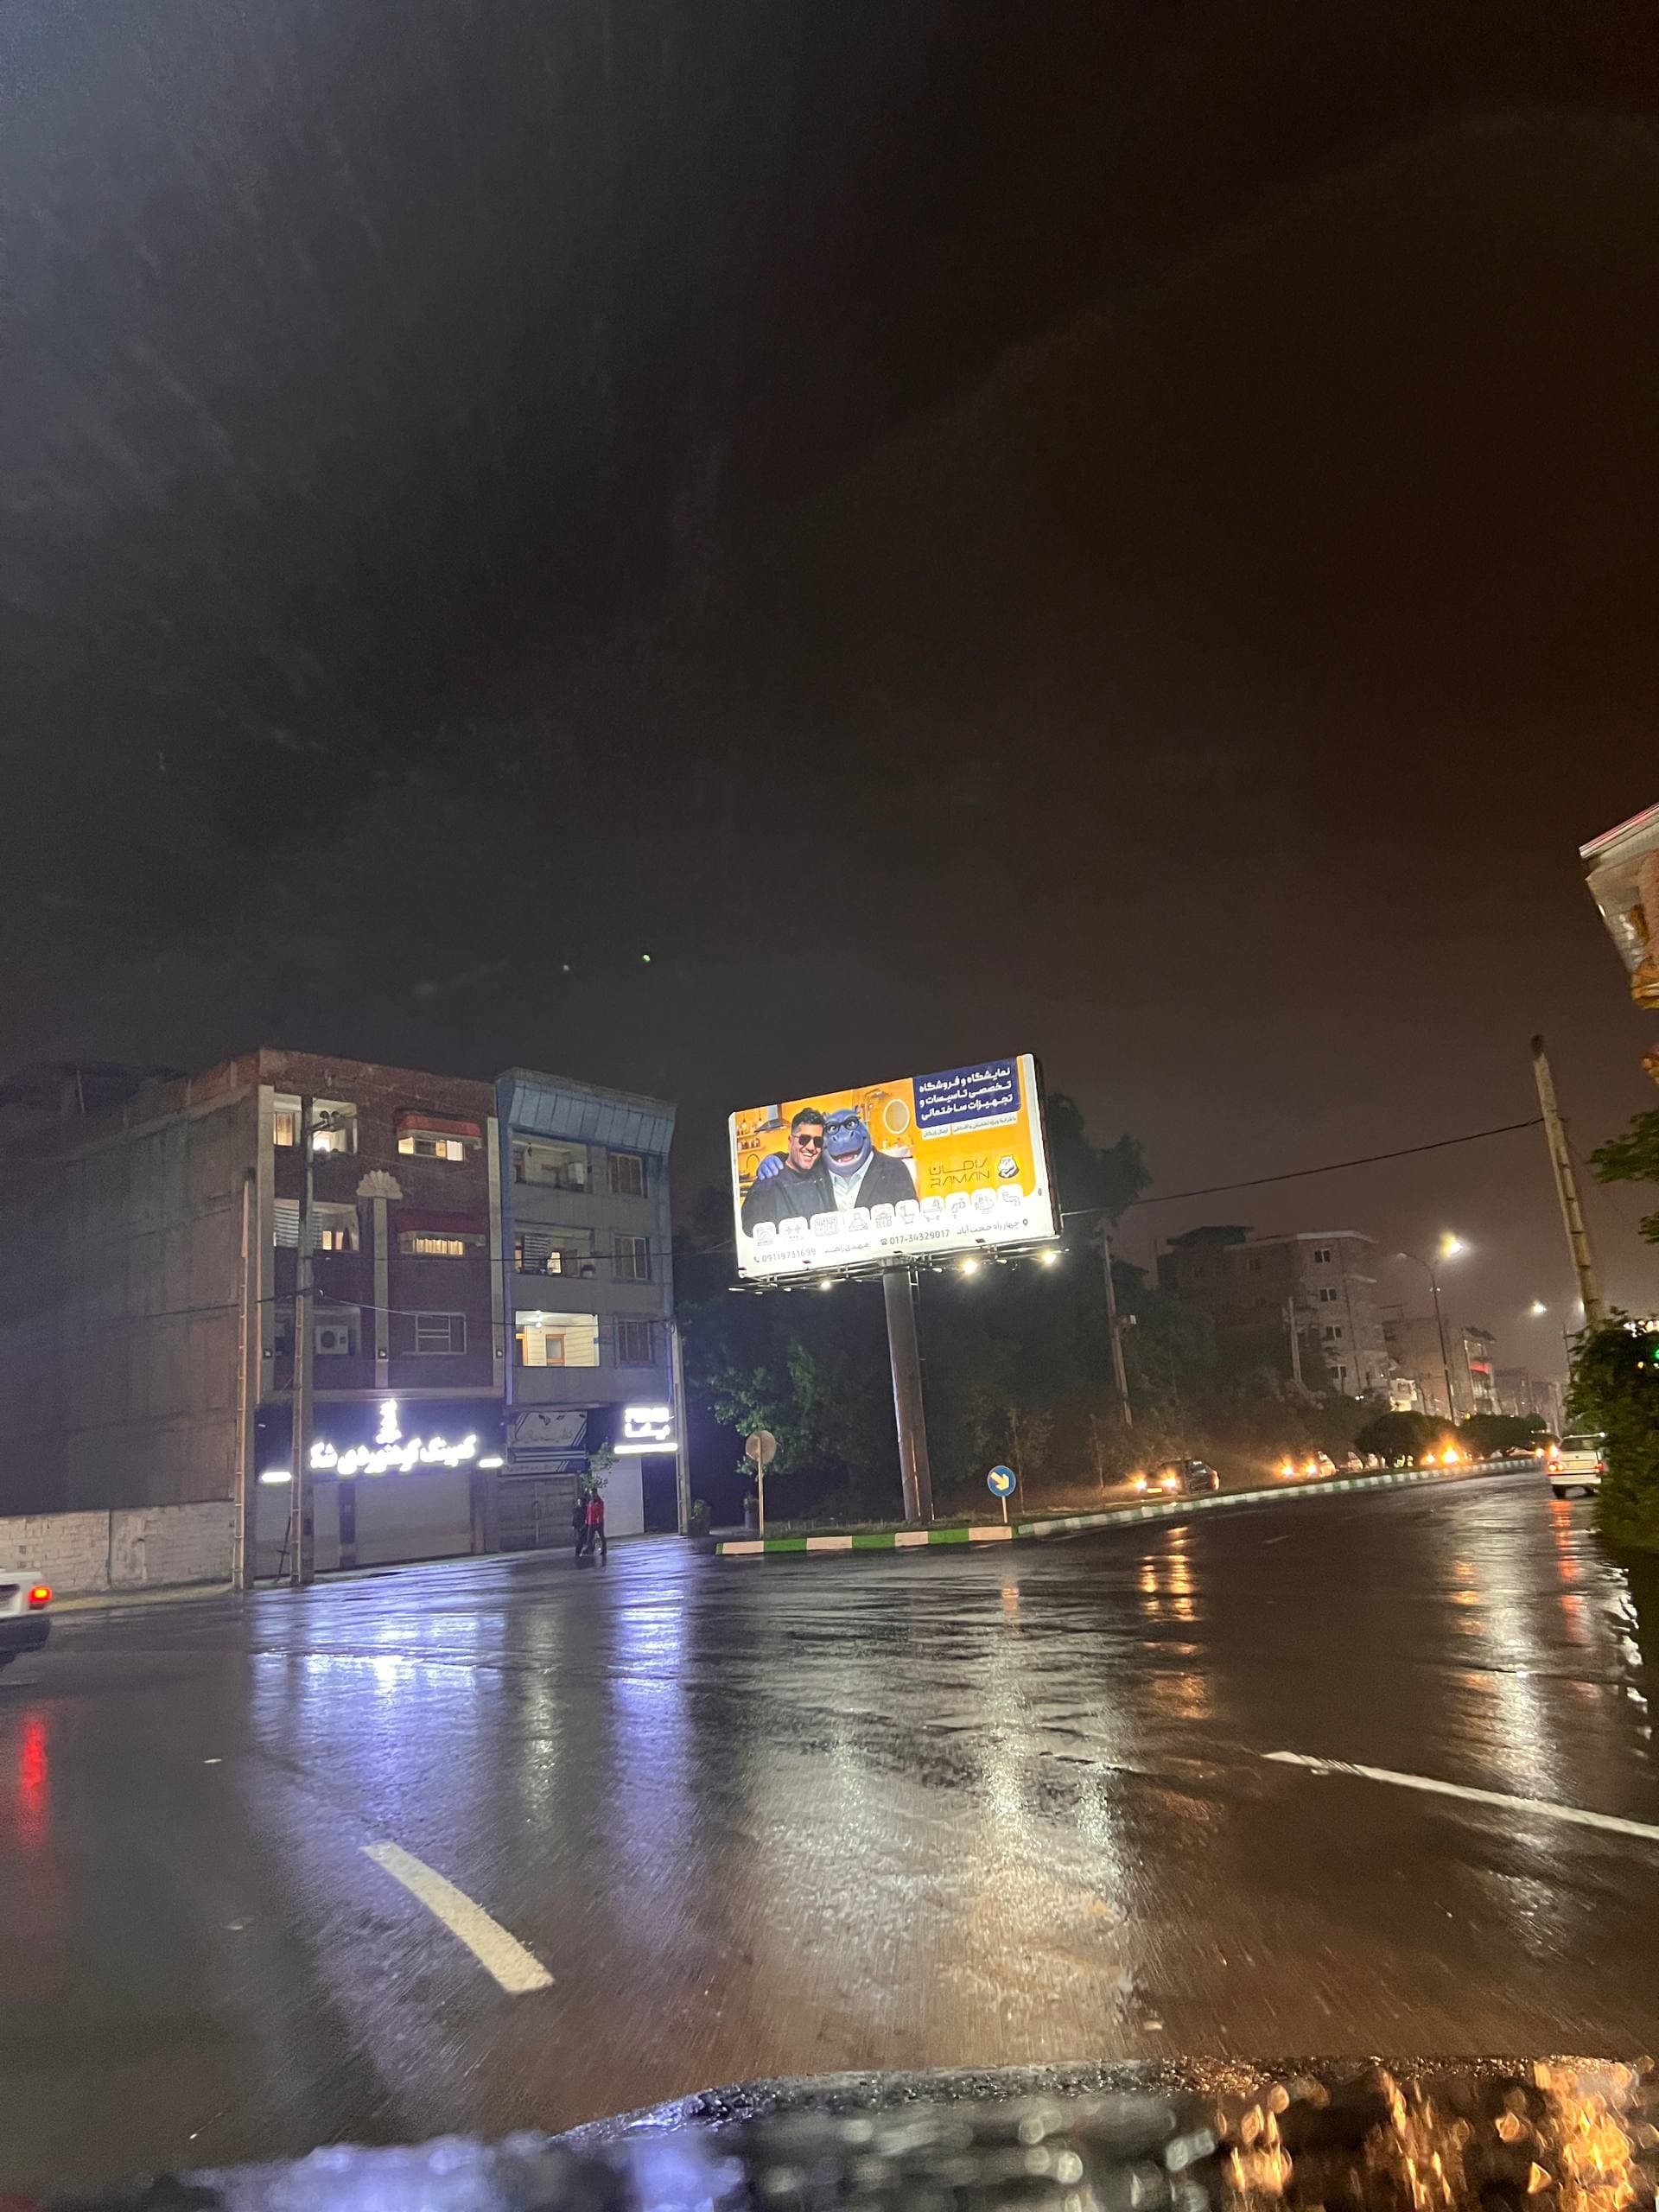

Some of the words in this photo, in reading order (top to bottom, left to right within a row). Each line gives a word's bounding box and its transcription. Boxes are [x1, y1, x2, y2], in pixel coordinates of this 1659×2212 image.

[961, 1078, 967, 1087] و
[968, 1067, 1010, 1084] نمایشگاه
[919, 1076, 960, 1092] فروشگاه
[969, 1080, 1012, 1098] تخصصی
[919, 1099, 925, 1108] و
[925, 1089, 968, 1104] تاسیسات
[968, 1093, 1014, 1110] تجهیزات
[921, 1103, 968, 1121] ساختمانی
[929, 1157, 988, 1176] رامان
[930, 1171, 990, 1187] RAMAN
[890, 1229, 950, 1245] 017-34329017
[762, 1248, 817, 1263] 09119731699
[845, 1243, 869, 1252] مهدی
